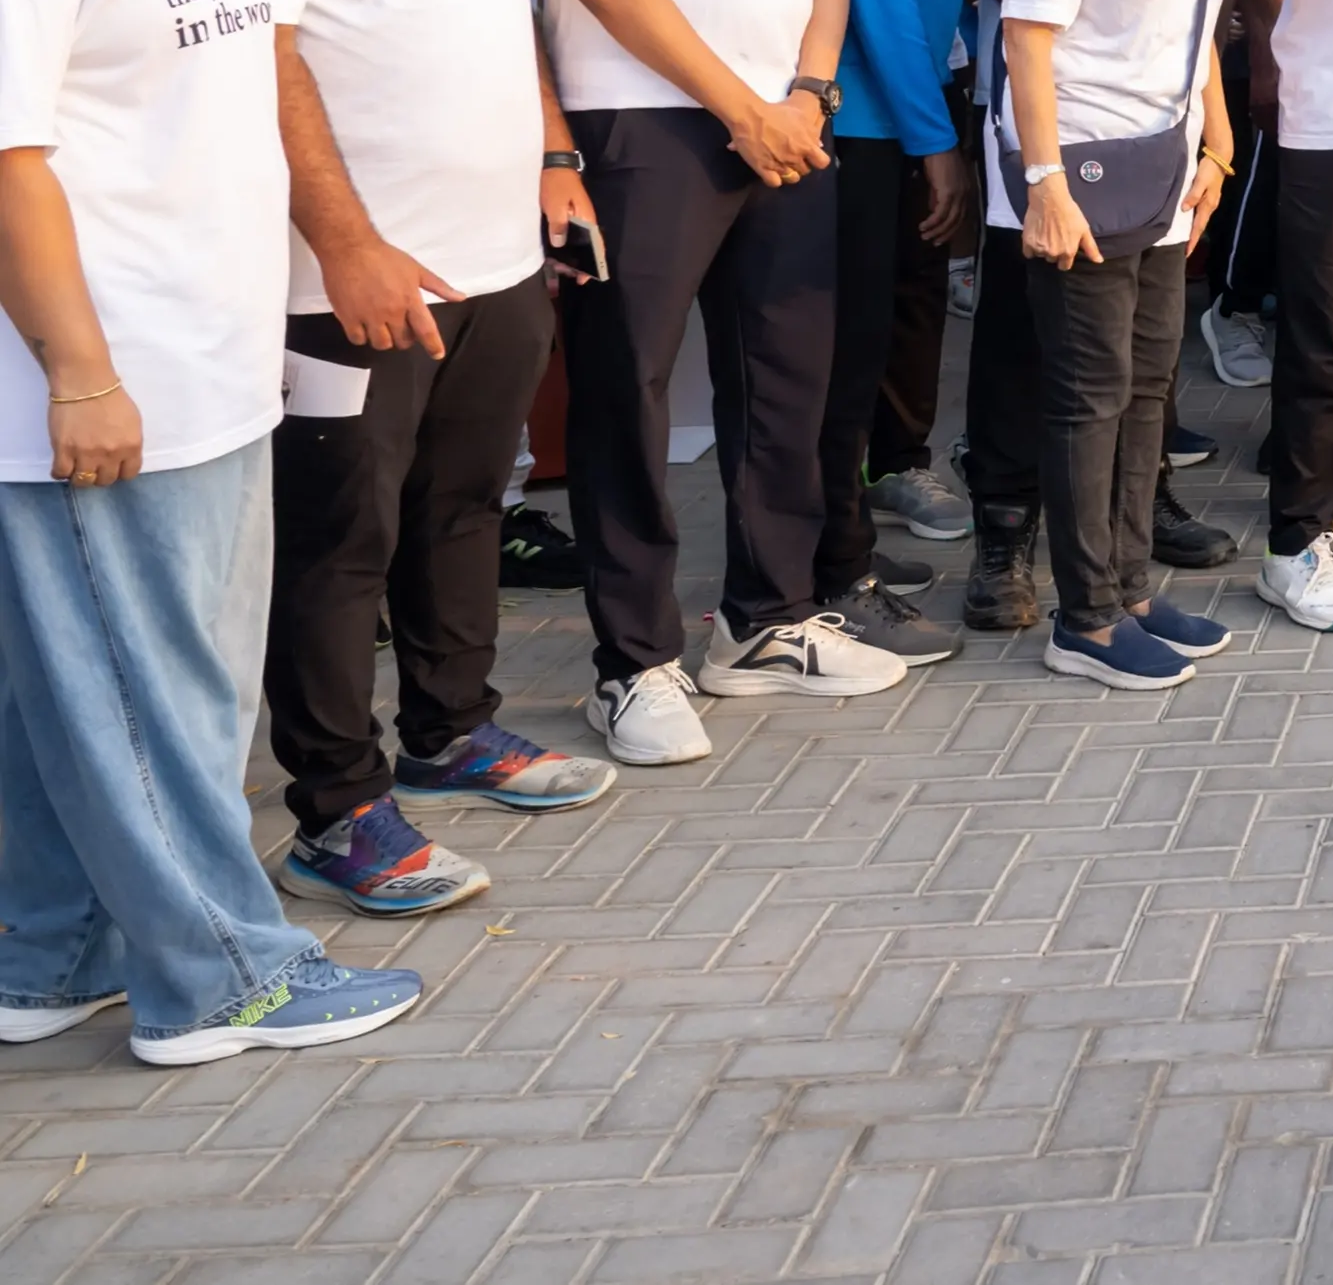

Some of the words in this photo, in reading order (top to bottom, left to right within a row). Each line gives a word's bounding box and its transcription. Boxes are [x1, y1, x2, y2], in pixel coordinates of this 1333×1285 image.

[175, 18, 210, 49] in
[215, 2, 245, 36] the
[229, 982, 293, 1027] NIKE
